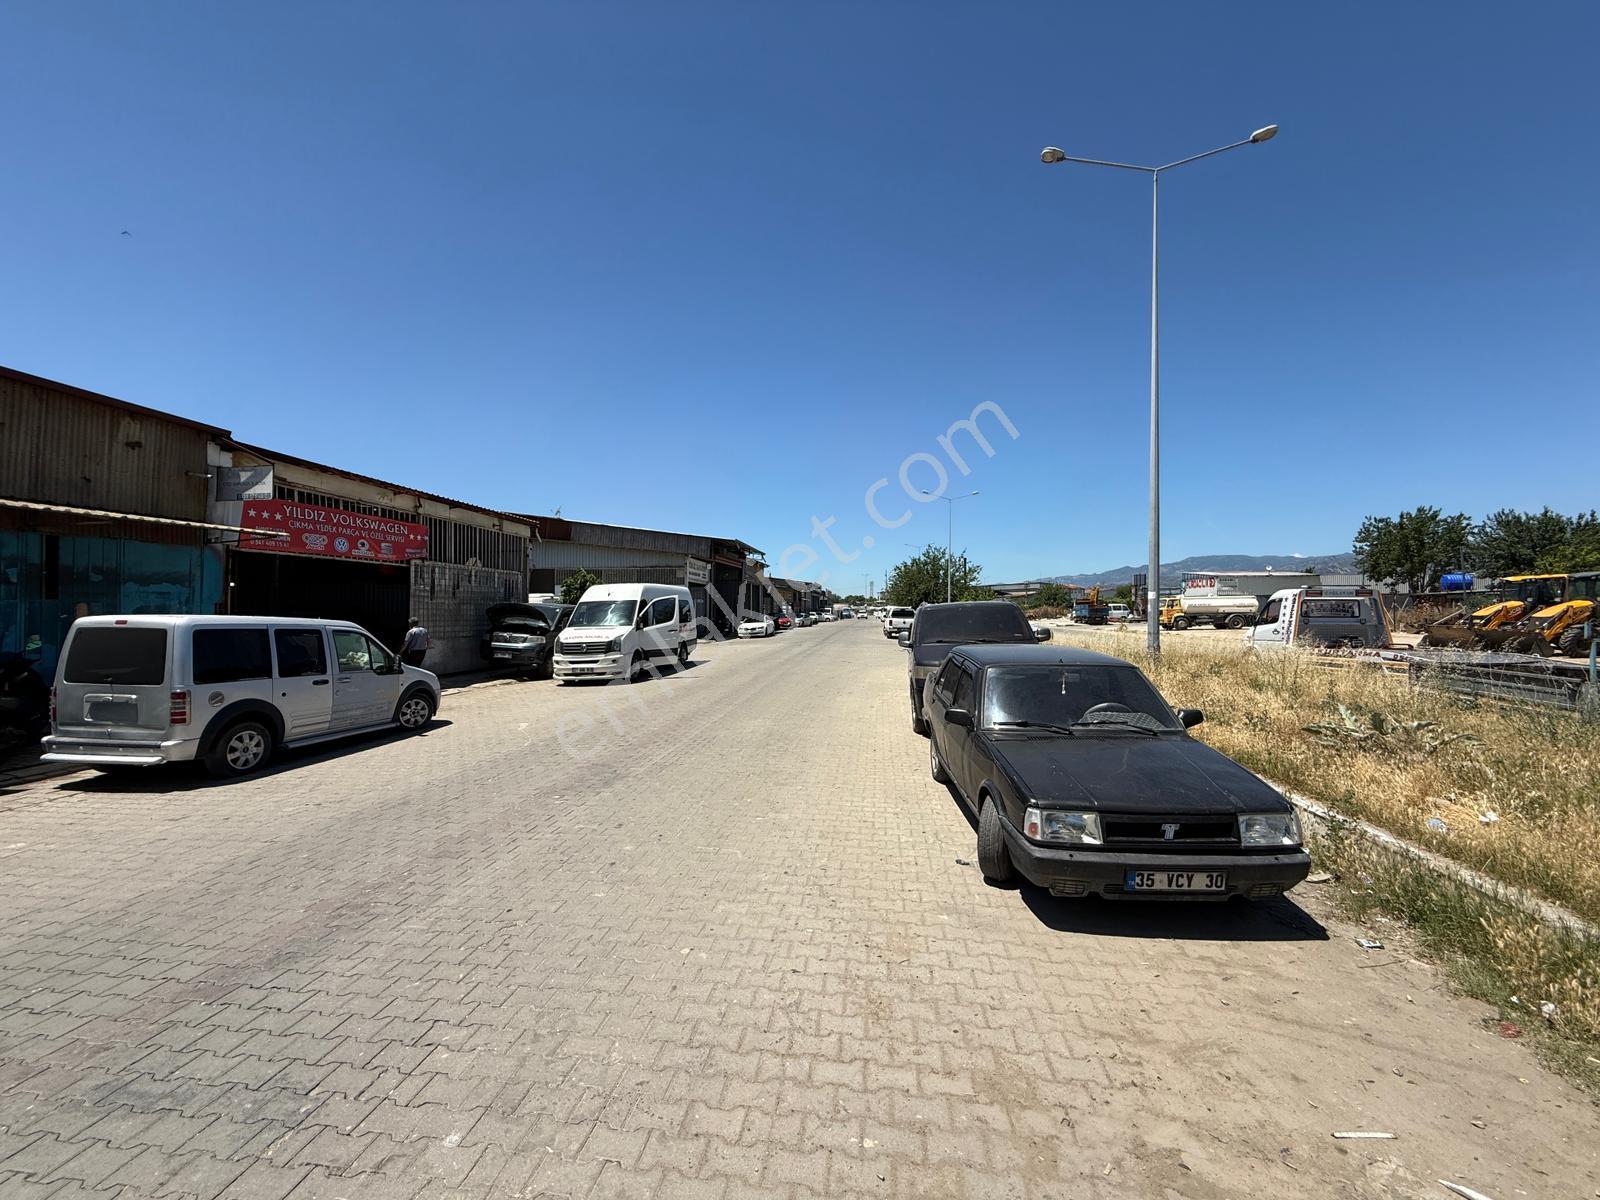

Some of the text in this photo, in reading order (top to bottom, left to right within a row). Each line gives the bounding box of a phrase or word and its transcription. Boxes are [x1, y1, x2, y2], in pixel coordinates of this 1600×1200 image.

[283, 504, 408, 535] YILDIZ VOLKSWAGEN
[315, 523, 337, 534] YEDEK
[361, 530, 370, 538] VE
[1135, 872, 1224, 888] 35 VCY 30
